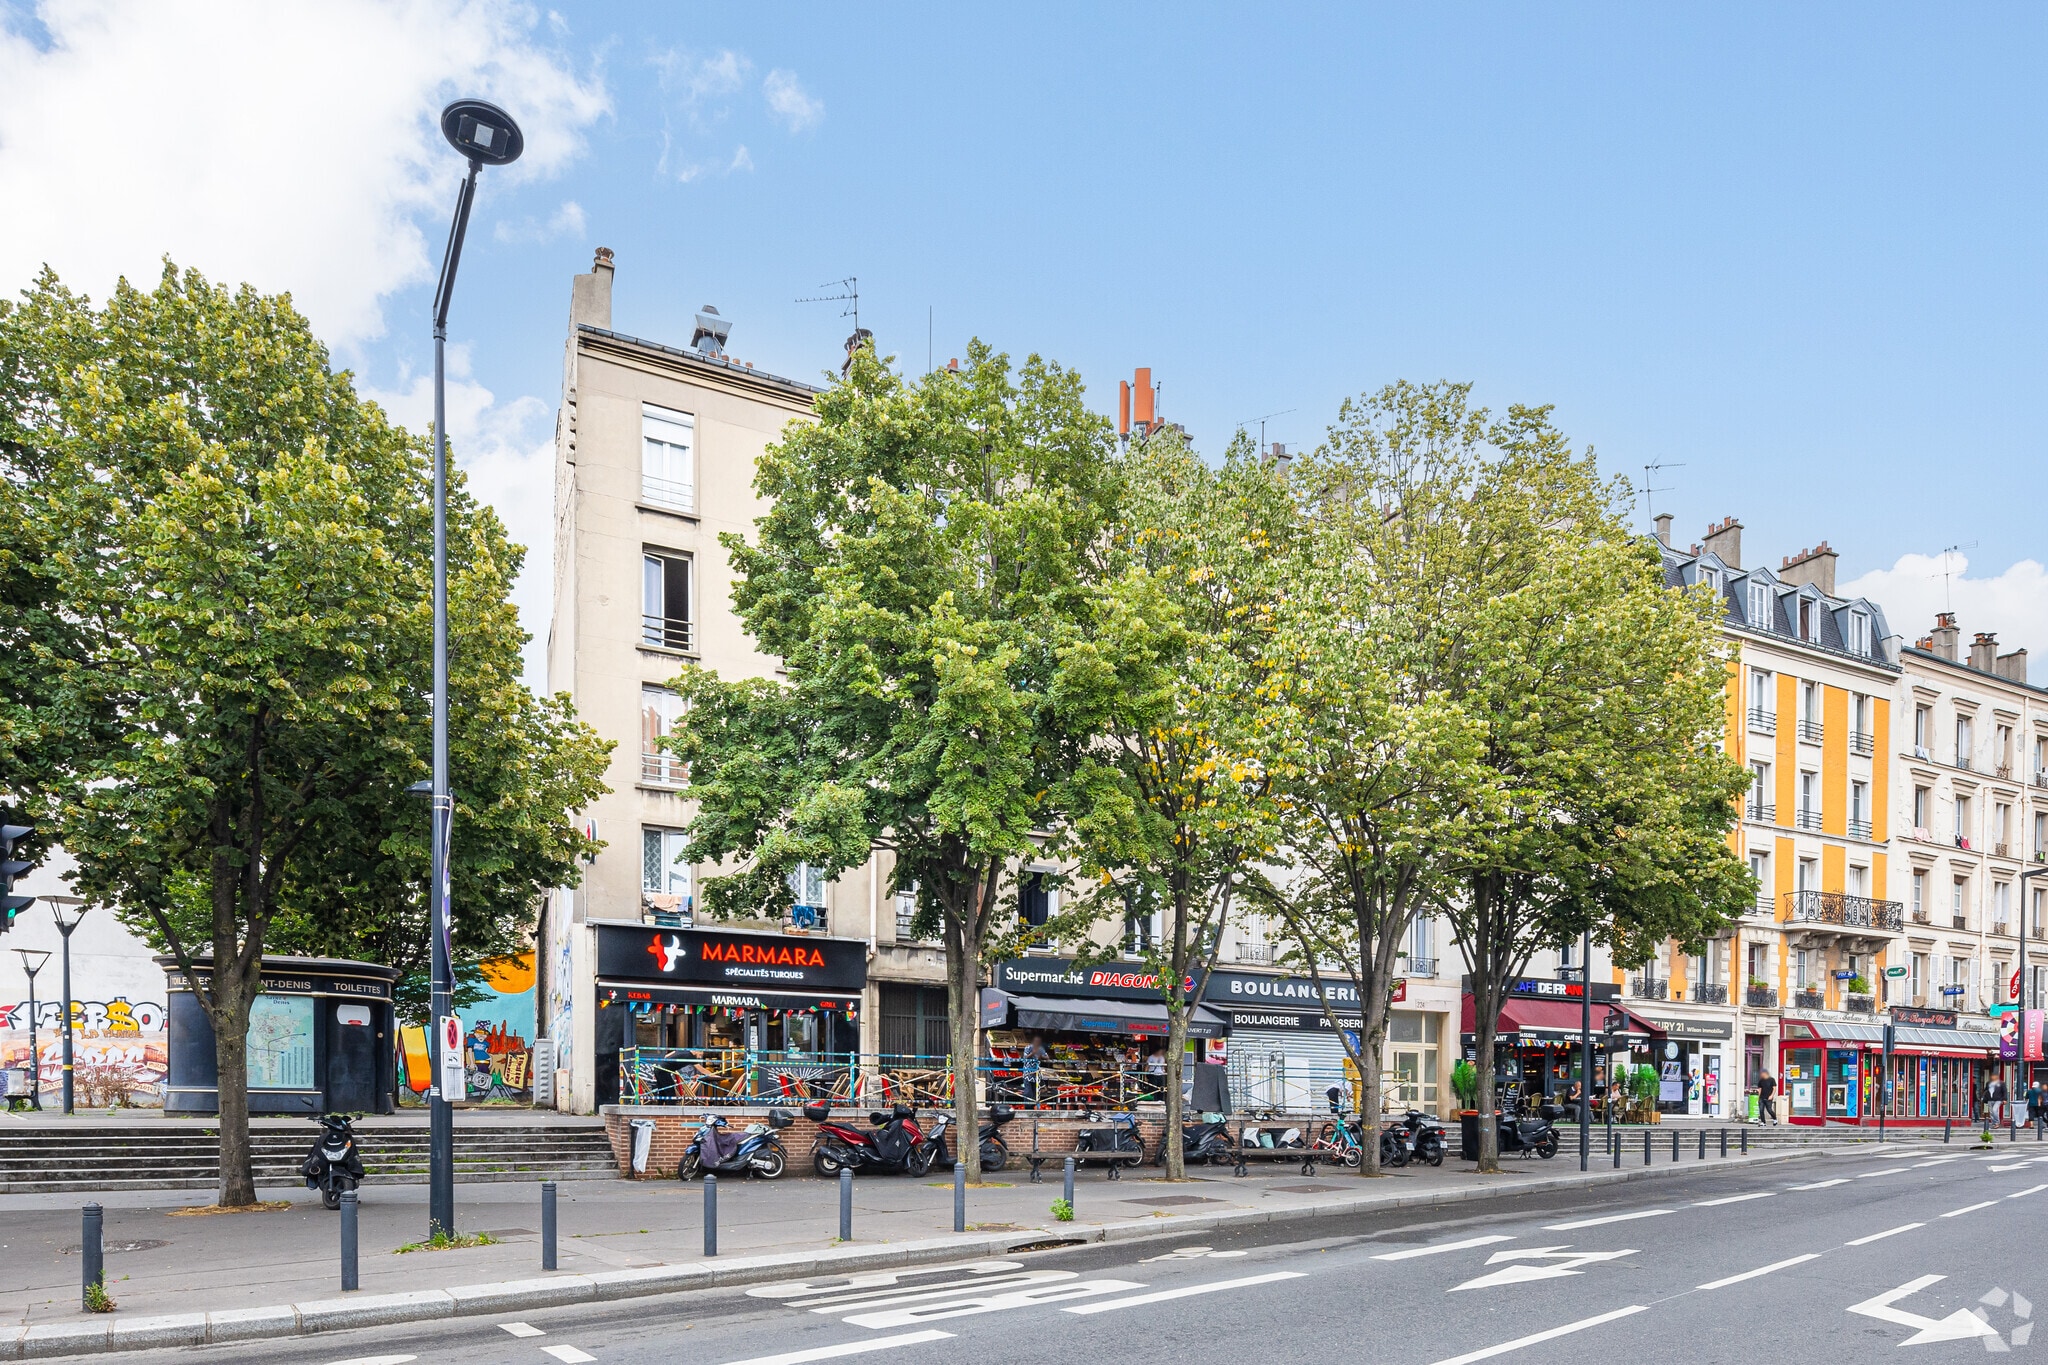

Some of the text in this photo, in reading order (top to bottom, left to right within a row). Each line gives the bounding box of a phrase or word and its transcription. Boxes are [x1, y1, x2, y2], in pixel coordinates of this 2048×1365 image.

[702, 942, 825, 967] MARMARA
[725, 967, 804, 979] SPÉCIALITÉS TURQUES
[1006, 967, 1084, 984] Supermarché
[334, 982, 381, 994] TOILETTES
[1538, 982, 1552, 994] DE
[627, 991, 651, 1000] KEBAB
[711, 994, 760, 1007] MARMARA
[820, 1001, 837, 1009] GRILL
[1234, 1015, 1300, 1026] BOULANGERIE
[1676, 1021, 1684, 1032] 21
